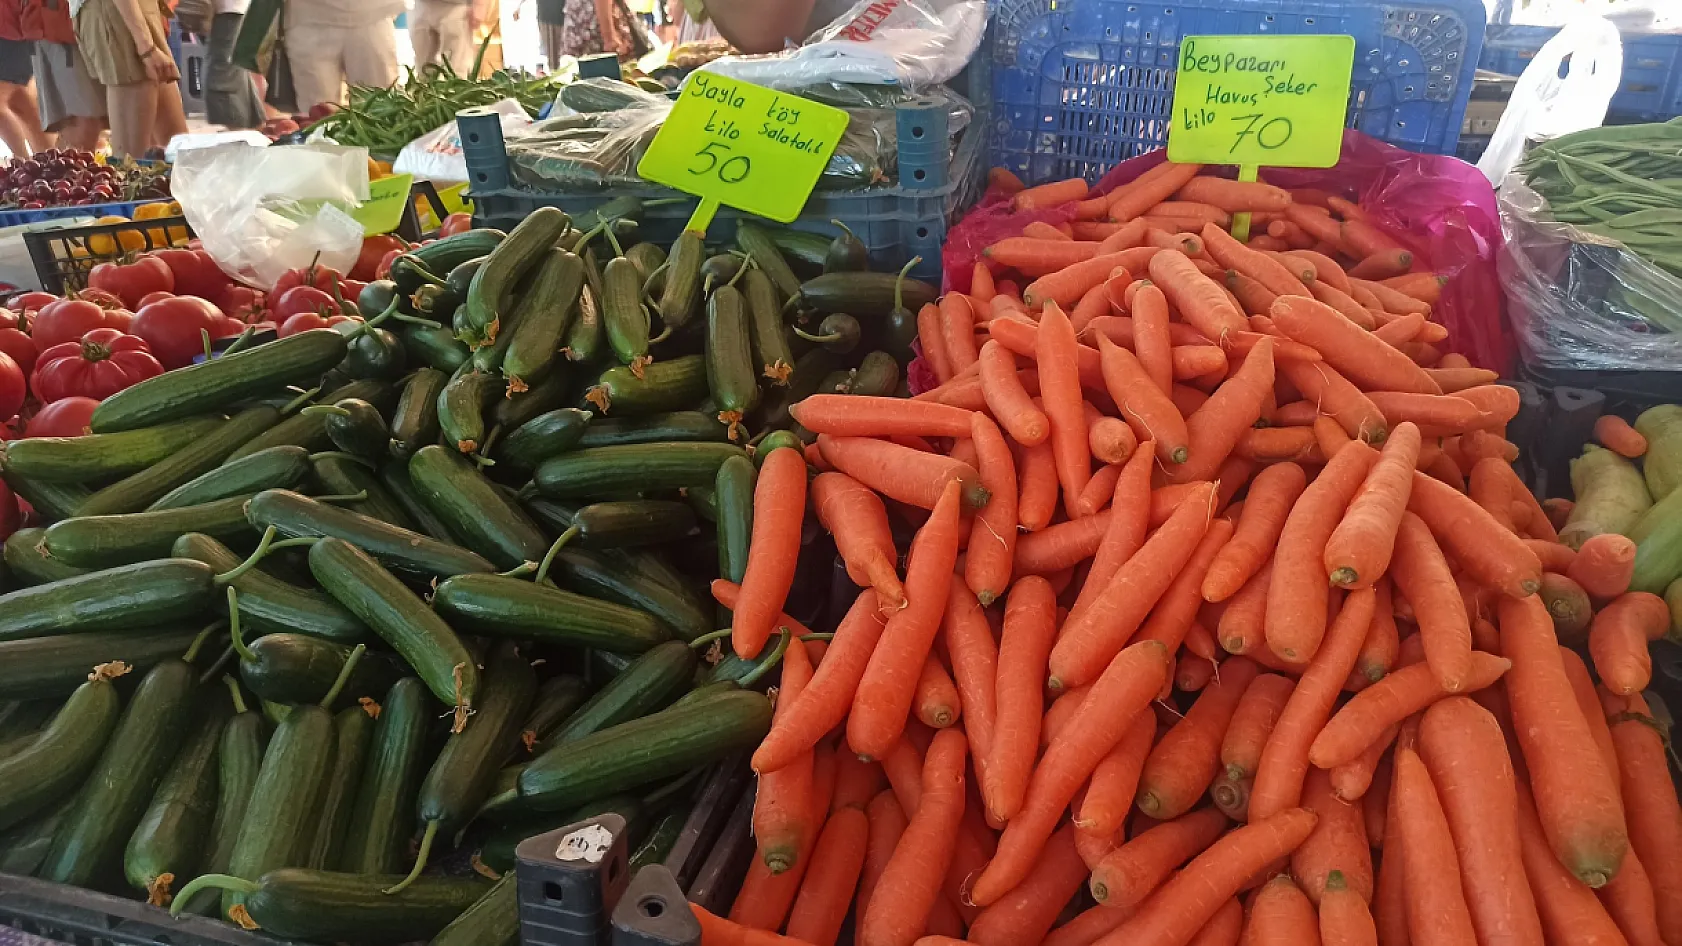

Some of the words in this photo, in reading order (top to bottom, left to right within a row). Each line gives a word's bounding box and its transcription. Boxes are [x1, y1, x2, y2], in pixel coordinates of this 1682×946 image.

[1263, 73, 1318, 98] Şeker
[704, 110, 740, 140] kilo
[1183, 107, 1215, 130] kilo
[1229, 113, 1293, 154] 70
[687, 142, 751, 184] 50
